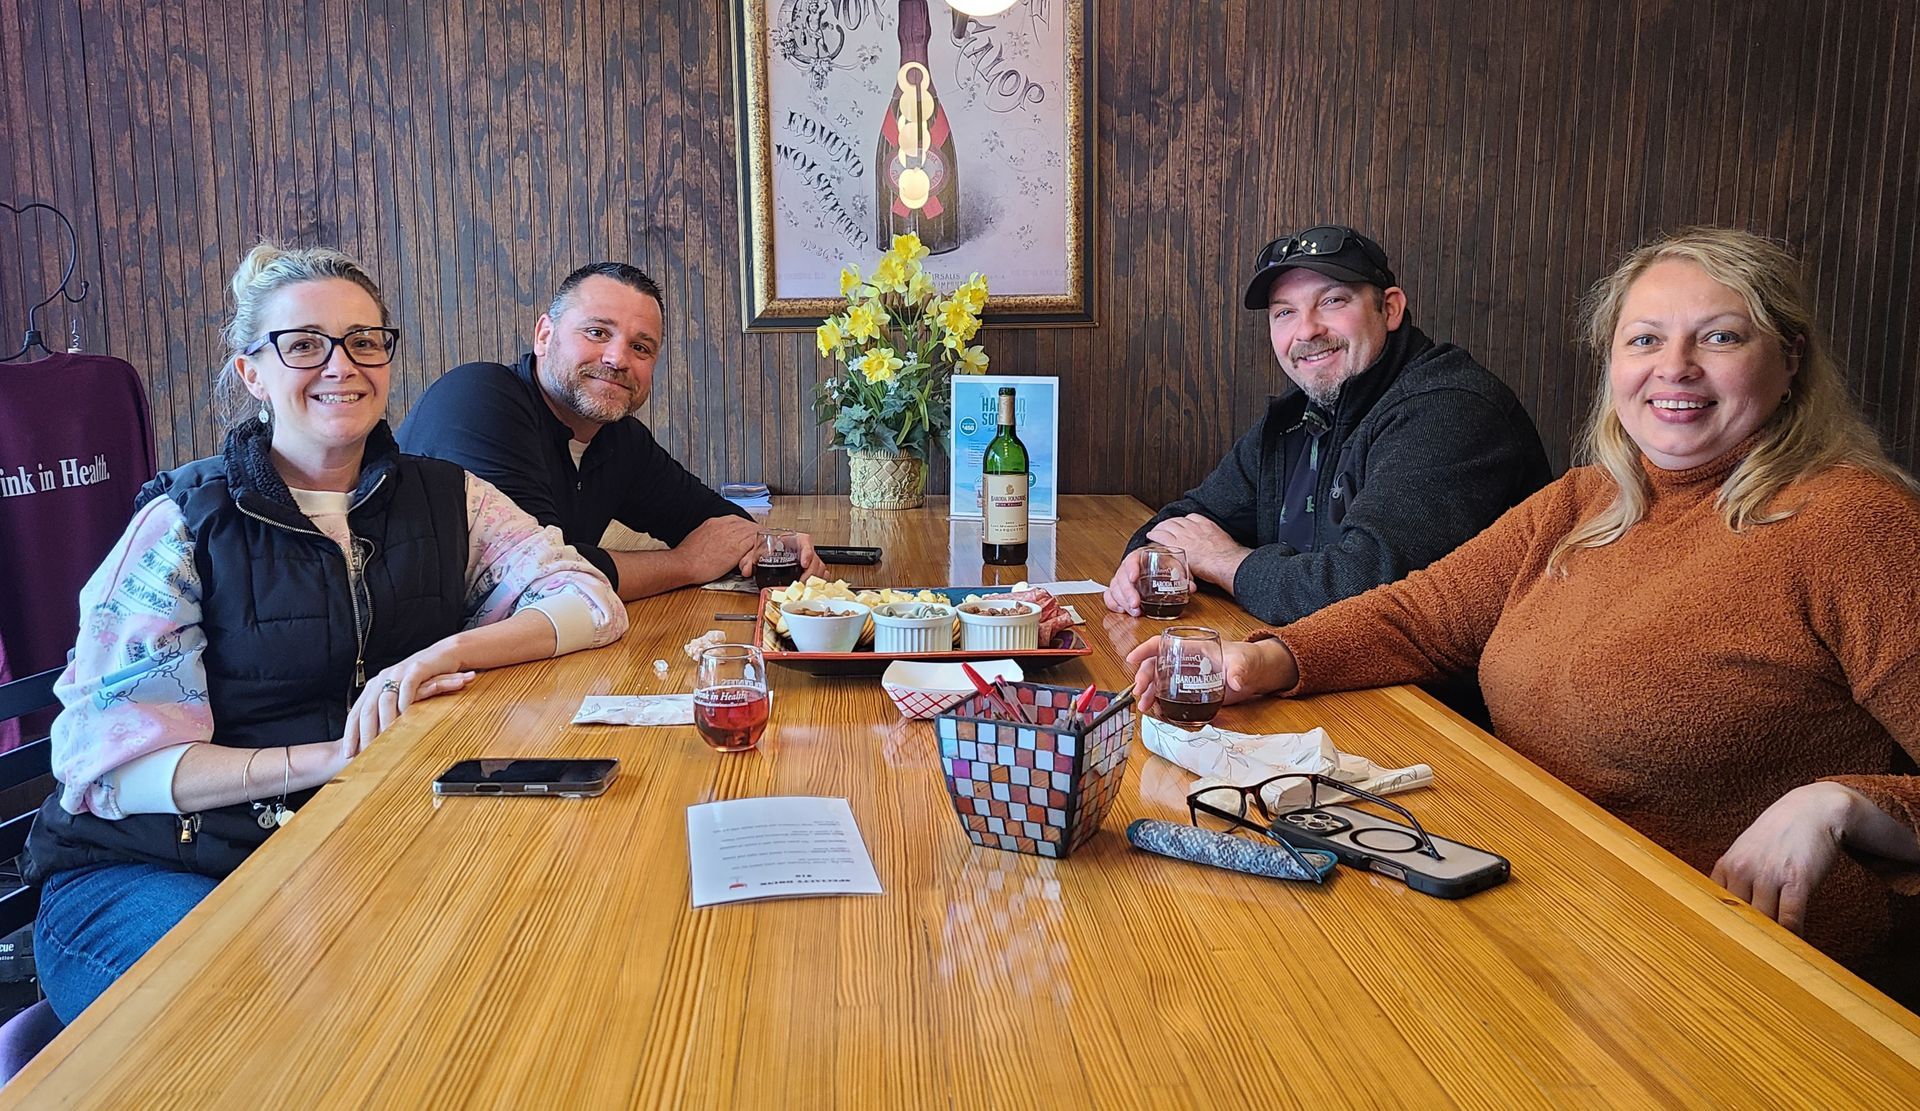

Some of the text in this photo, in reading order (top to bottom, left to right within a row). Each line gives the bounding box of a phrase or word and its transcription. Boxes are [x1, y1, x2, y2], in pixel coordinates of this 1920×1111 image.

[834, 113, 851, 128] BY
[782, 109, 865, 178] EDMUND
[38, 463, 56, 492] in
[59, 454, 110, 488] Health.
[1175, 674, 1203, 684] BARODA
